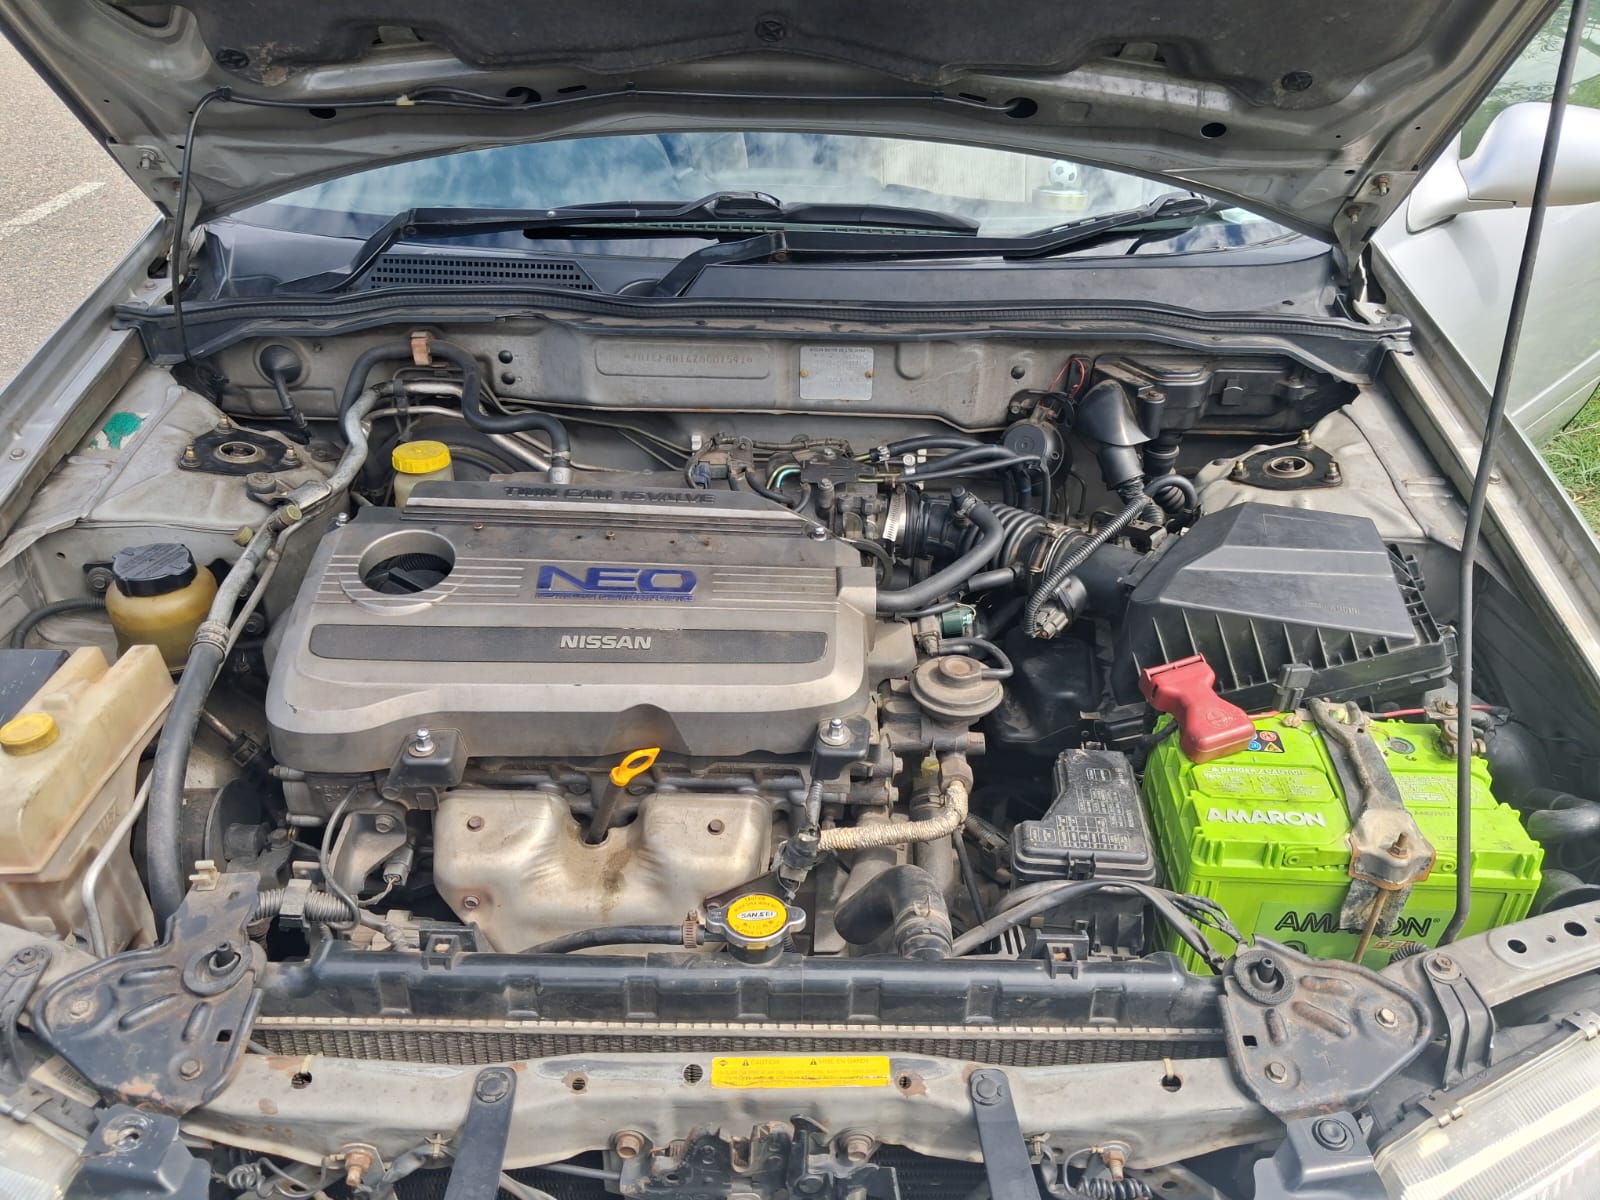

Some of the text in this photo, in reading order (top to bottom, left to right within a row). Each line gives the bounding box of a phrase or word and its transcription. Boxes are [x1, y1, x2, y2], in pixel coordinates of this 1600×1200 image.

[563, 488, 613, 500] CAM
[536, 565, 697, 595] NEO
[559, 634, 652, 650] NISSAN
[1207, 807, 1327, 828] AMARON
[1274, 911, 1433, 938] AMON
